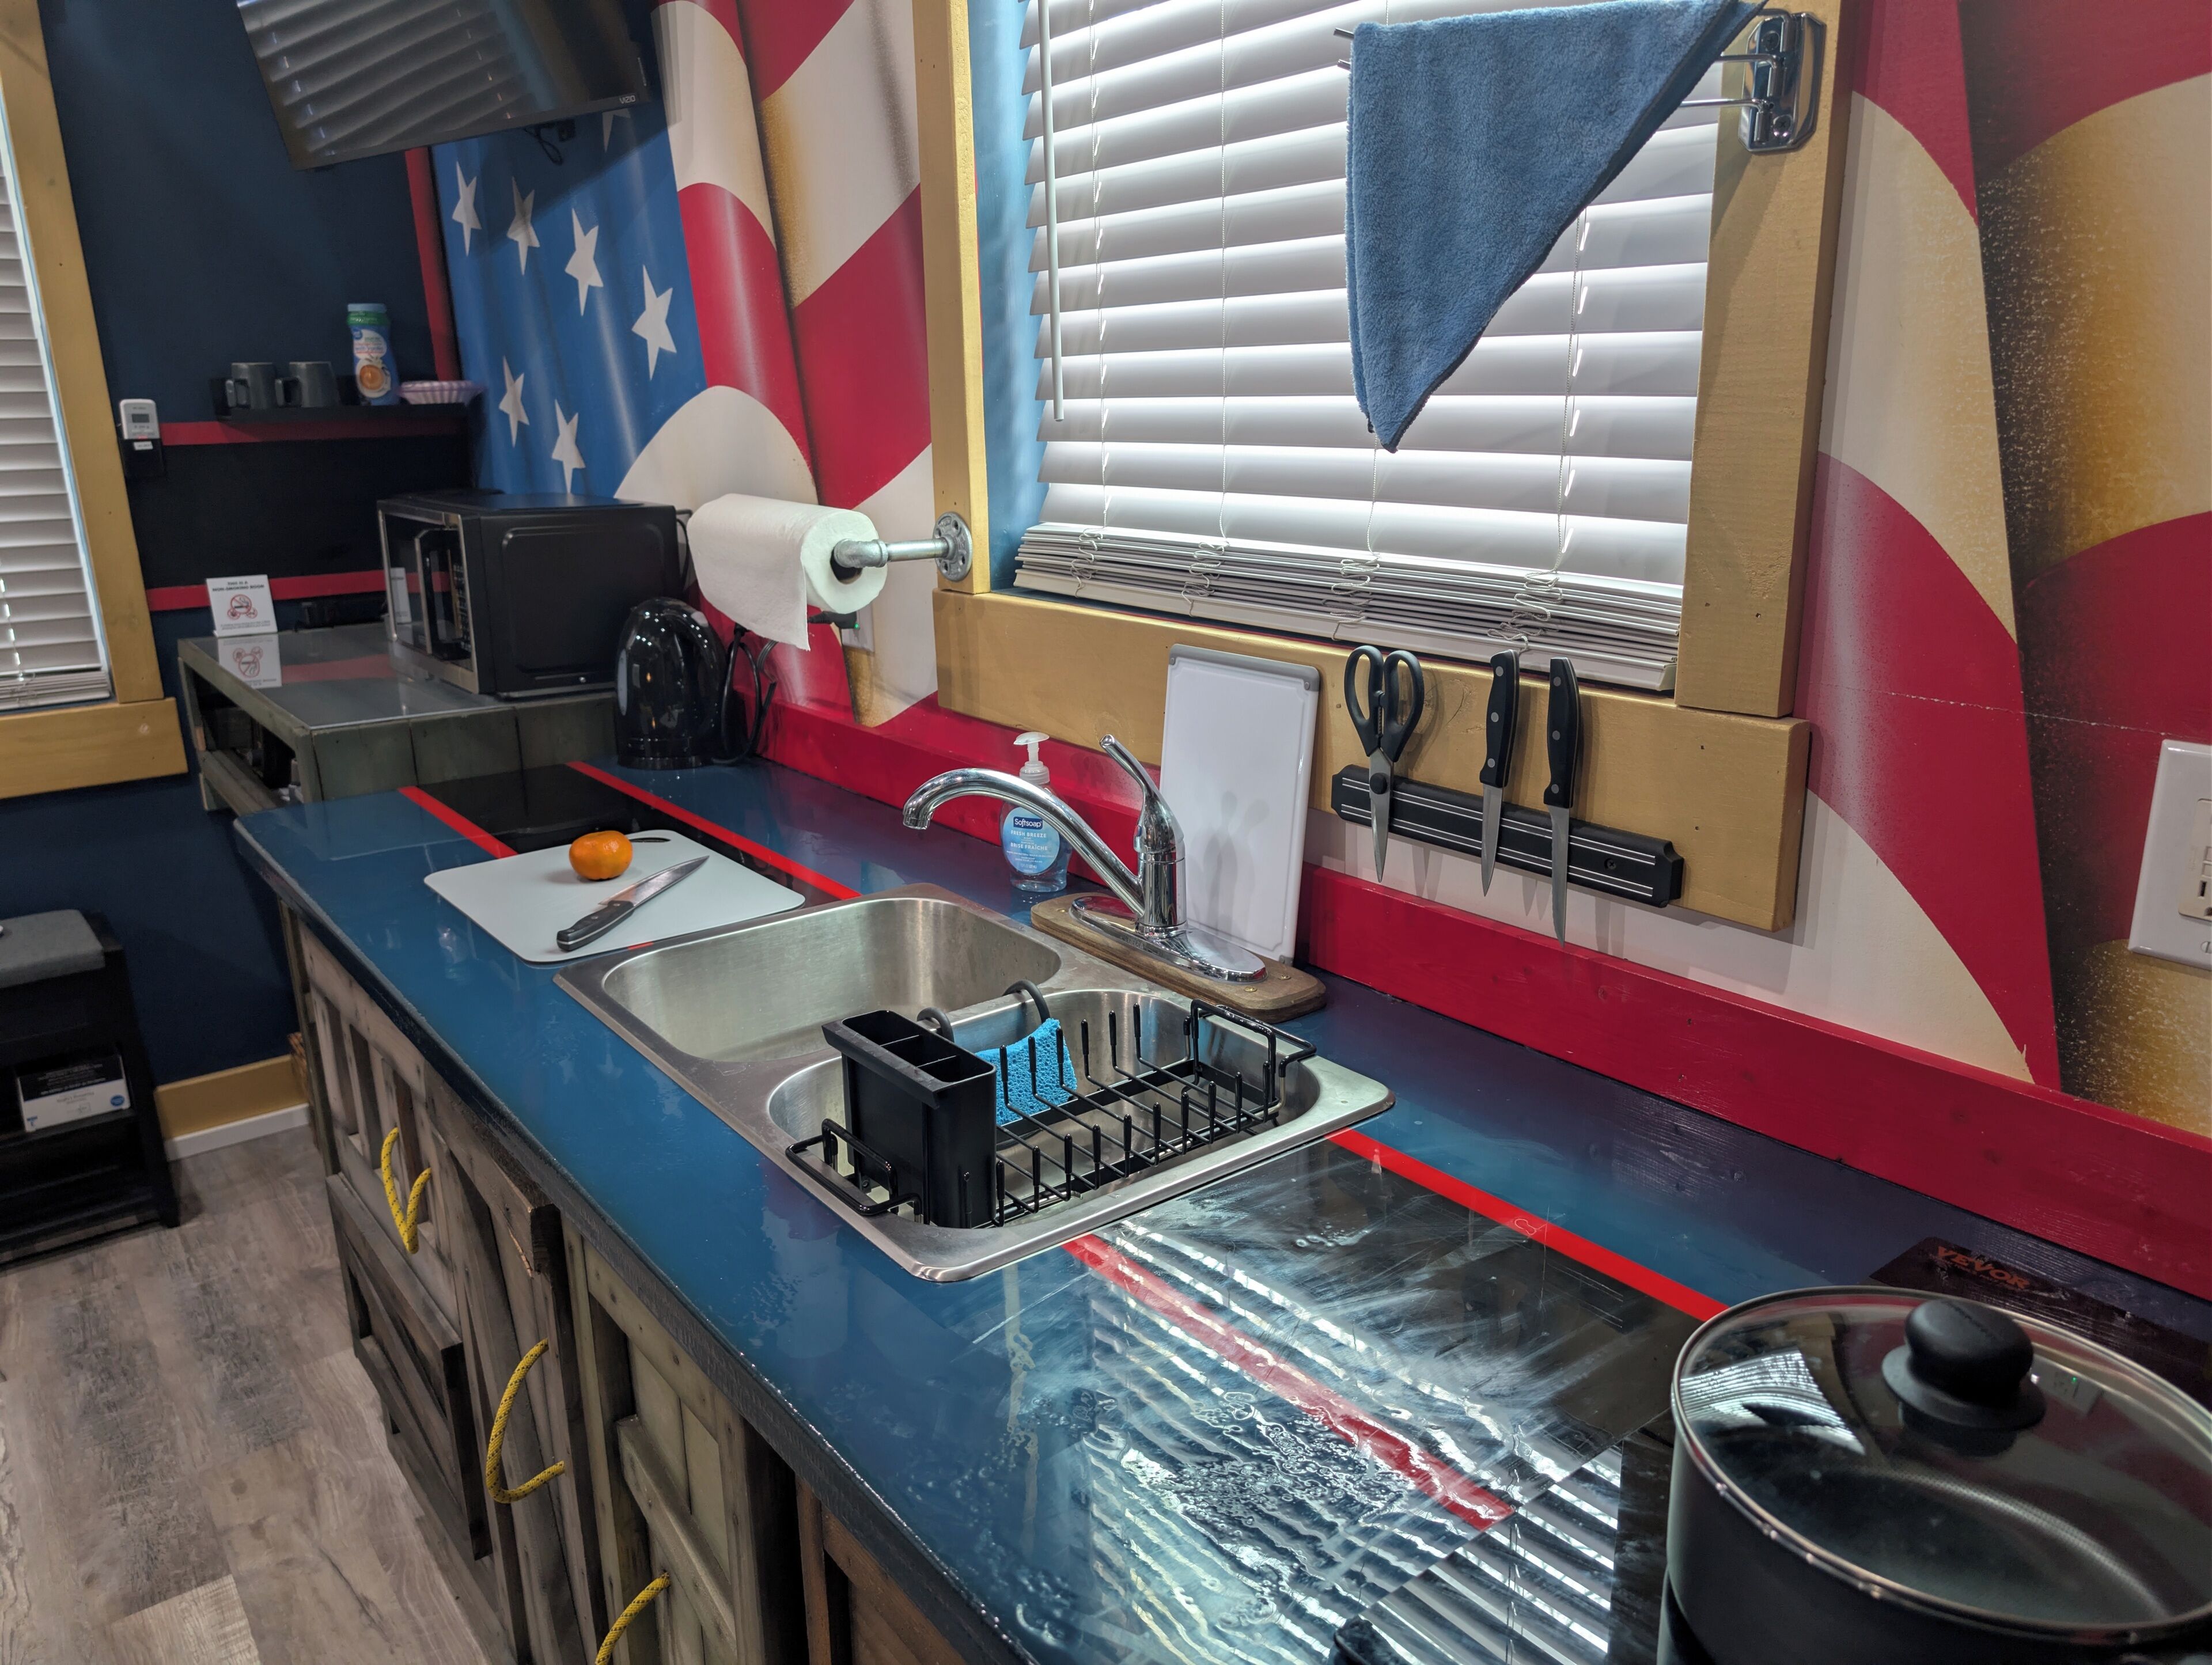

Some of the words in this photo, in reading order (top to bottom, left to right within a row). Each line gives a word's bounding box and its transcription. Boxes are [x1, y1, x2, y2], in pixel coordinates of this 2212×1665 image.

[619, 95, 636, 104] VIZIO
[1014, 818, 1041, 828] Softsoap
[1938, 1246, 2030, 1289] VEVOR
